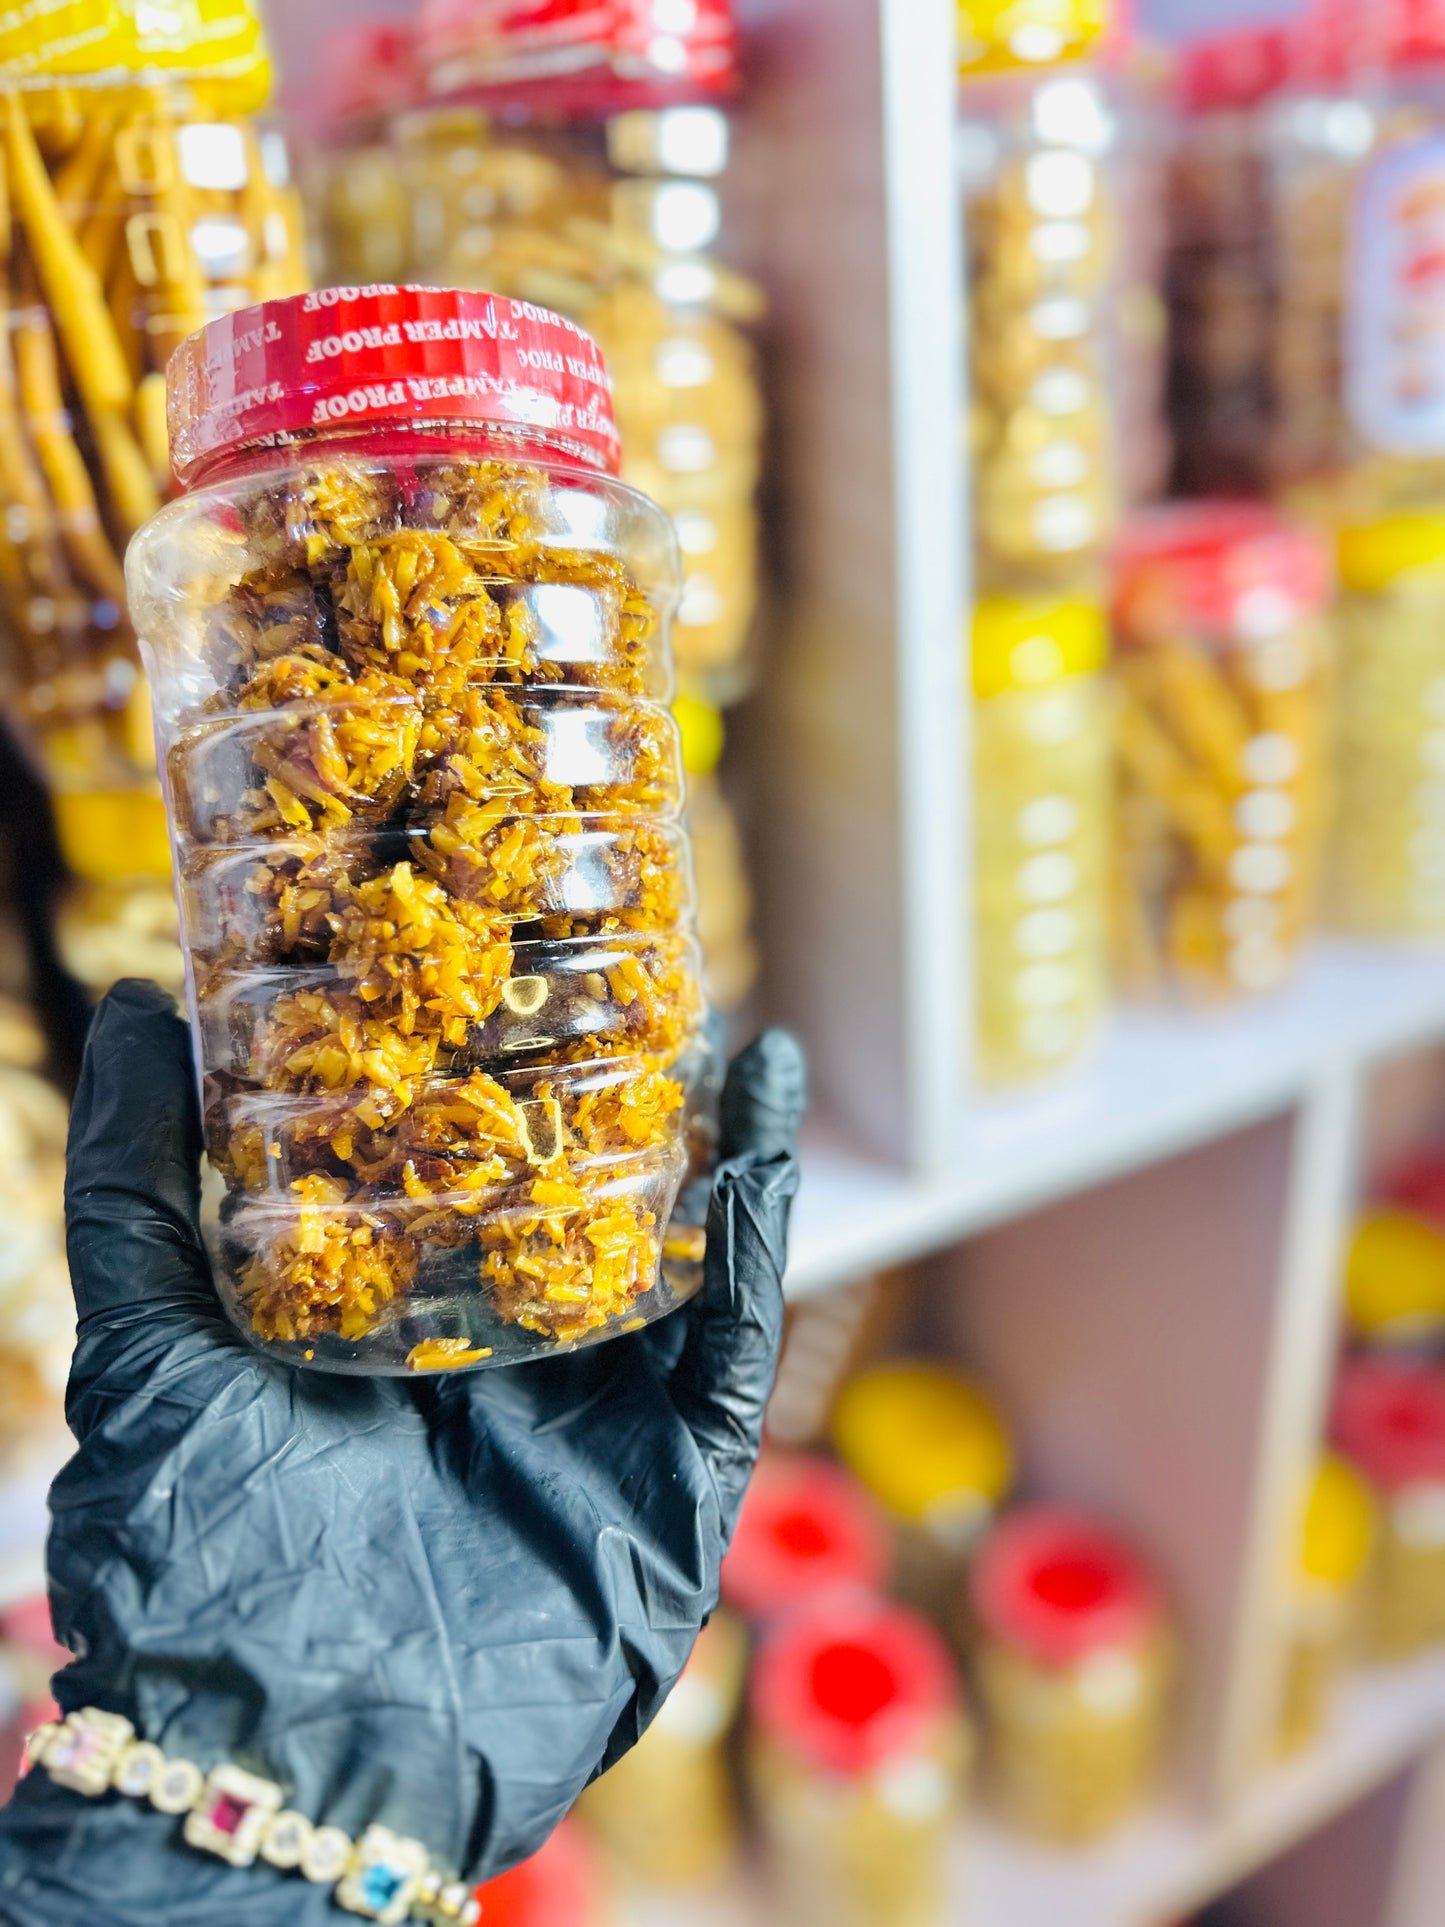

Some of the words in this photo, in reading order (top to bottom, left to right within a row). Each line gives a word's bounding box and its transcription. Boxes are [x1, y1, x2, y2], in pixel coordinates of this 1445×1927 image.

[306, 324, 403, 363] PROOF
[402, 320, 519, 342] TAMPER
[312, 380, 408, 424] PROOF
